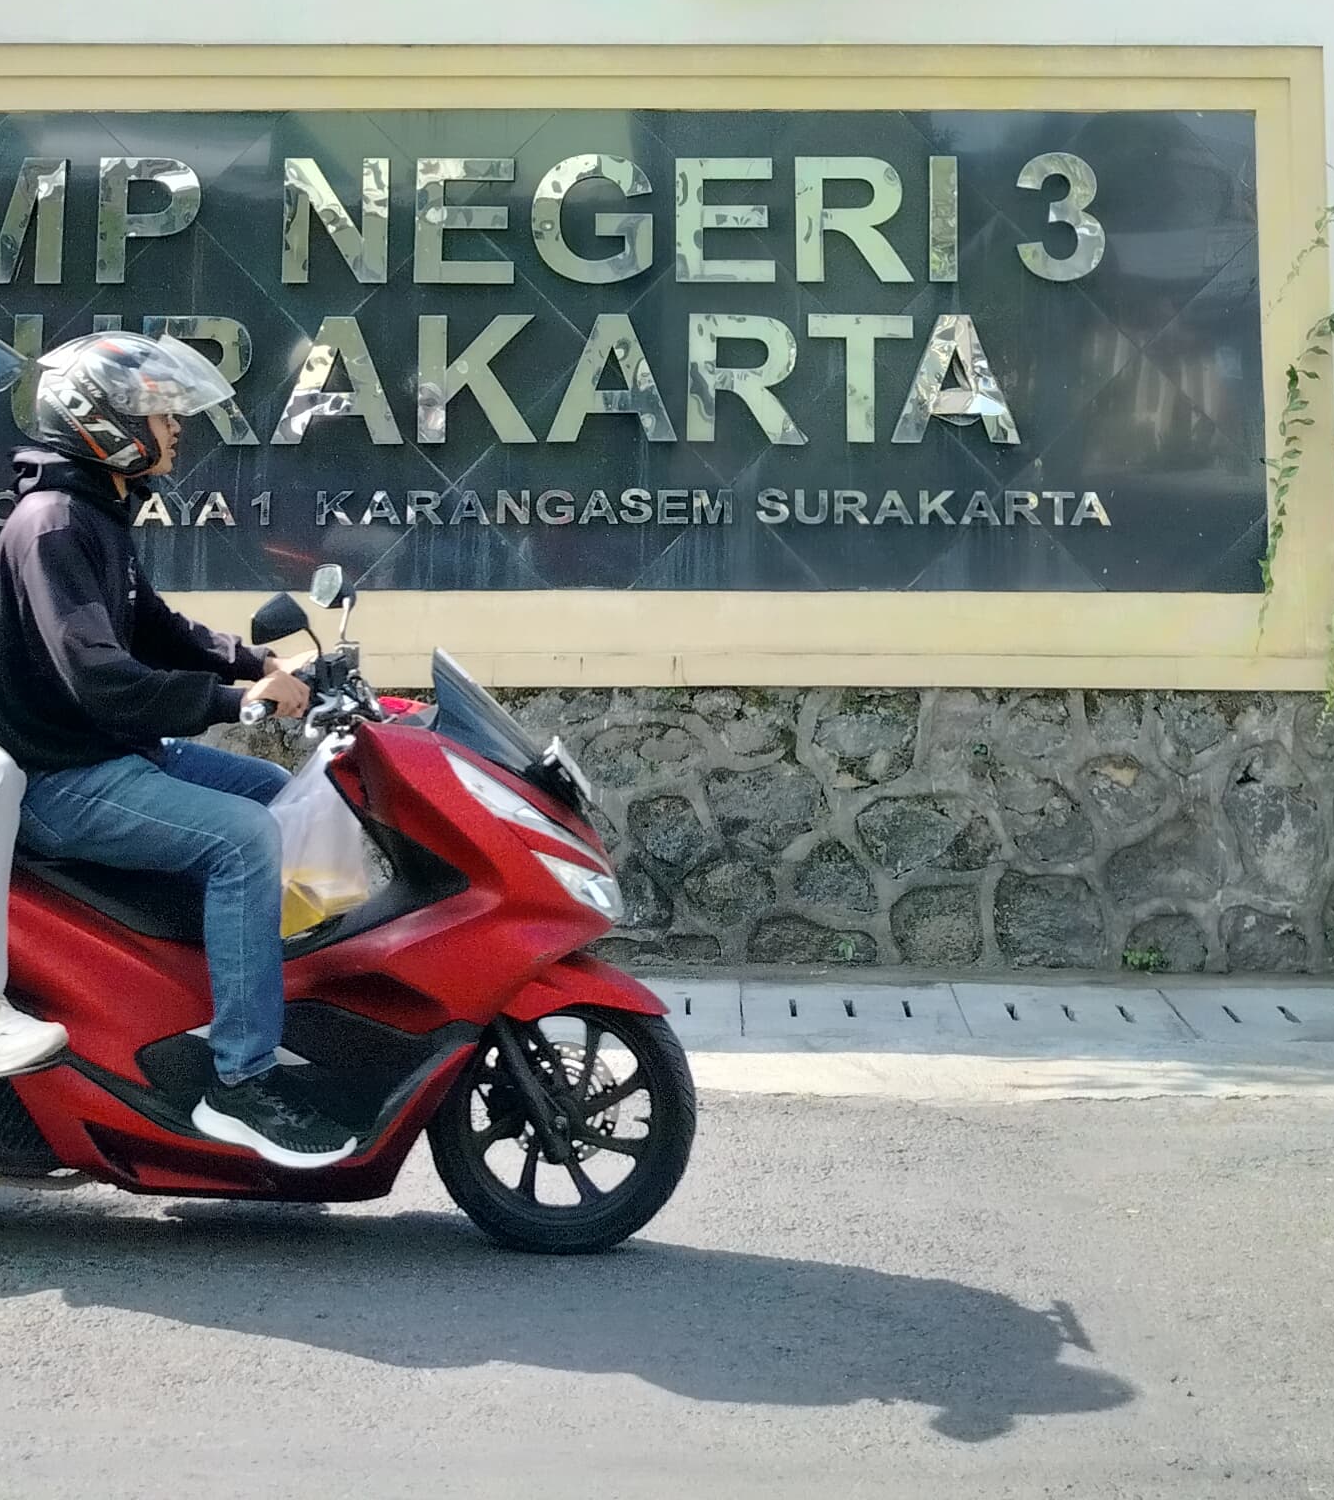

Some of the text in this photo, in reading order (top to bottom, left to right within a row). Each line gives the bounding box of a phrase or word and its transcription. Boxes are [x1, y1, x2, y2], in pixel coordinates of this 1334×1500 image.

[281, 153, 959, 286] NEGERI
[1015, 151, 1107, 283] 3
[132, 490, 237, 528] AYA
[251, 490, 272, 527] 1
[315, 488, 734, 528] KARANGASEM
[755, 487, 1113, 528] SURAKARTA
